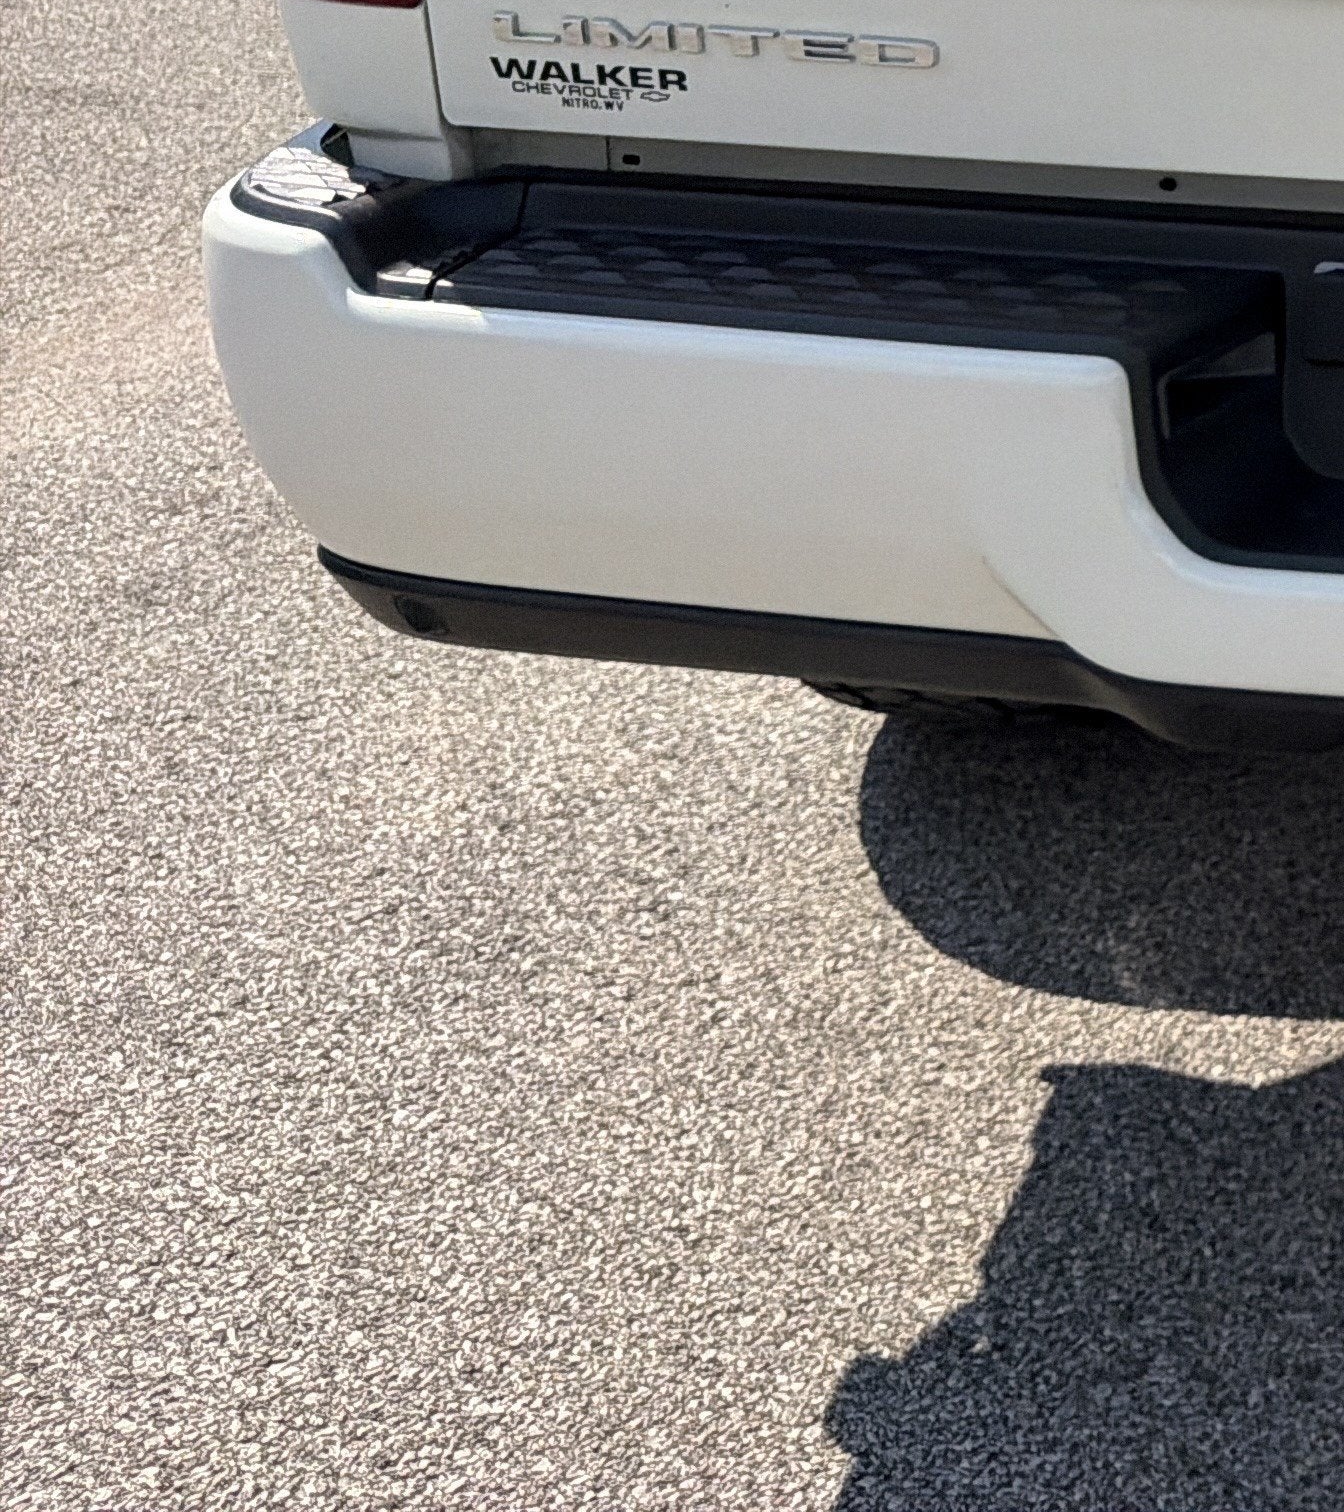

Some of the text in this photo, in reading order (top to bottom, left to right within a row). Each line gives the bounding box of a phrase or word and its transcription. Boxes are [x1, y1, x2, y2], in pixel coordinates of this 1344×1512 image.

[491, 9, 940, 69] LIMITED
[489, 56, 689, 91] WALKER
[511, 80, 634, 101] CHEVROLET
